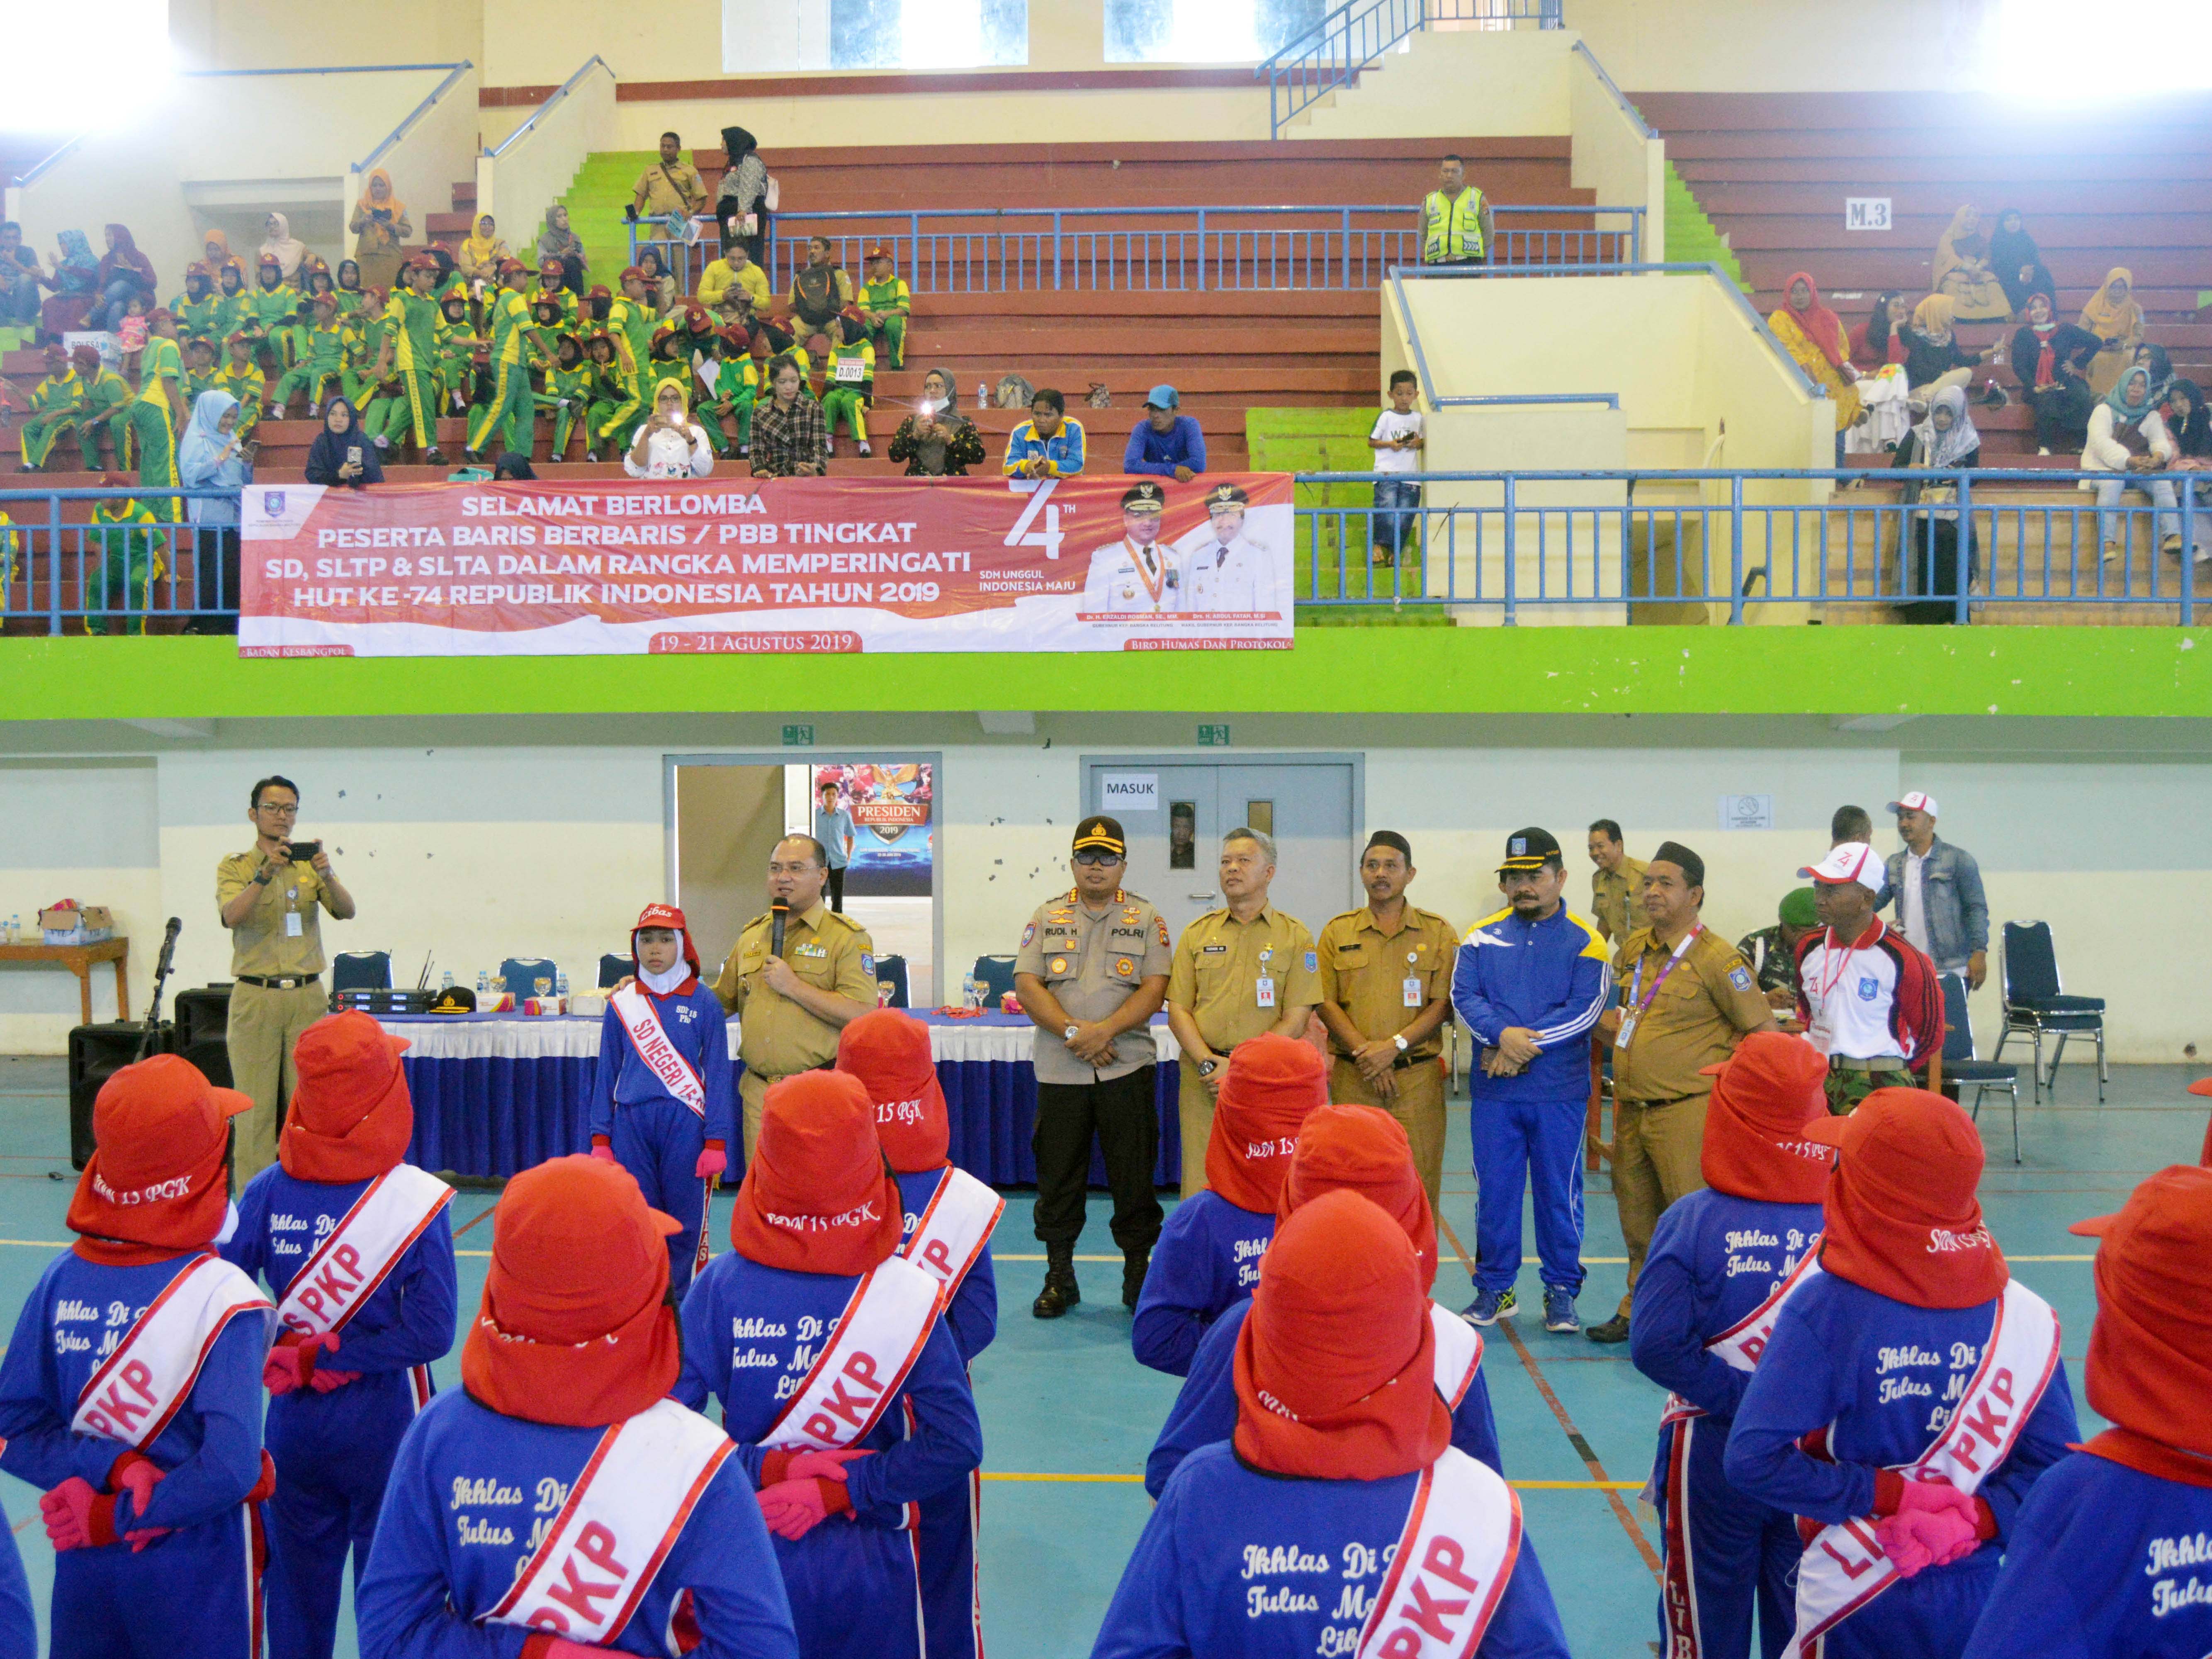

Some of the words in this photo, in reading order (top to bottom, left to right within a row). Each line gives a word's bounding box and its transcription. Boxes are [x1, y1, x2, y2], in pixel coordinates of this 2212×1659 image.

[1850, 203, 1887, 226] M.3
[839, 367, 862, 378] D.0013
[462, 496, 598, 516] SELAMAT
[606, 494, 767, 515] BERLOMBA
[1063, 504, 1076, 513] TH
[318, 527, 445, 548] PESERTA
[453, 526, 535, 545] BARIS
[544, 525, 685, 545] BERBARIS
[693, 525, 711, 544] /
[720, 524, 778, 544] PBB
[784, 523, 916, 543] TINGKAT
[267, 559, 308, 581] SD,
[317, 558, 386, 577] SLTP
[393, 557, 412, 576] &
[419, 556, 491, 575] SLTA
[498, 555, 601, 574] DALAM
[608, 555, 735, 574] RANGKA
[743, 552, 970, 573] MEMPERINGATI
[1003, 570, 1044, 579] UNGGUL
[294, 587, 353, 606] HUT
[450, 584, 593, 605] REPUBLIK
[602, 584, 763, 603] INDONESIA
[770, 583, 873, 602] TAHUN
[880, 582, 939, 601] 2019
[980, 581, 1043, 591] INDONESIA
[1046, 581, 1075, 590] MAJU
[246, 647, 280, 657] BADAN
[283, 647, 345, 656] KESBANGPOL
[661, 636, 678, 650] 19
[698, 636, 715, 650] 21
[722, 636, 804, 650] AGUSTUS
[811, 635, 851, 649] 2019
[1132, 641, 1158, 649] BIRO
[1161, 640, 1200, 649] HUMAS
[1203, 640, 1227, 649] DAN
[1230, 640, 1287, 649] PROTOKOL
[1107, 783, 1154, 794] MASUK
[857, 806, 920, 817] PRESIDEN
[880, 826, 898, 834] 2019
[1111, 928, 1145, 938] POLRI
[688, 1010, 698, 1019] 15
[633, 1019, 656, 1041] SD
[643, 1036, 686, 1087] NEGERI
[877, 1102, 895, 1123] 15
[145, 1175, 192, 1202] PGK
[1786, 1228, 1804, 1251] Di
[297, 1243, 366, 1324] PKP
[105, 1301, 131, 1326] Di
[796, 1315, 823, 1341] Di
[1949, 1342, 1976, 1370] Di
[83, 1359, 159, 1443] PKP
[801, 1350, 885, 1447] PKP
[1948, 1367, 2015, 1474] PKP
[535, 1477, 568, 1513] Di
[1241, 1545, 1330, 1579] Ikhlas
[1342, 1542, 1378, 1579] Di
[525, 1520, 630, 1633] PKP
[1247, 1585, 1320, 1618] Tulus
[1377, 1534, 1480, 1659] PKP
